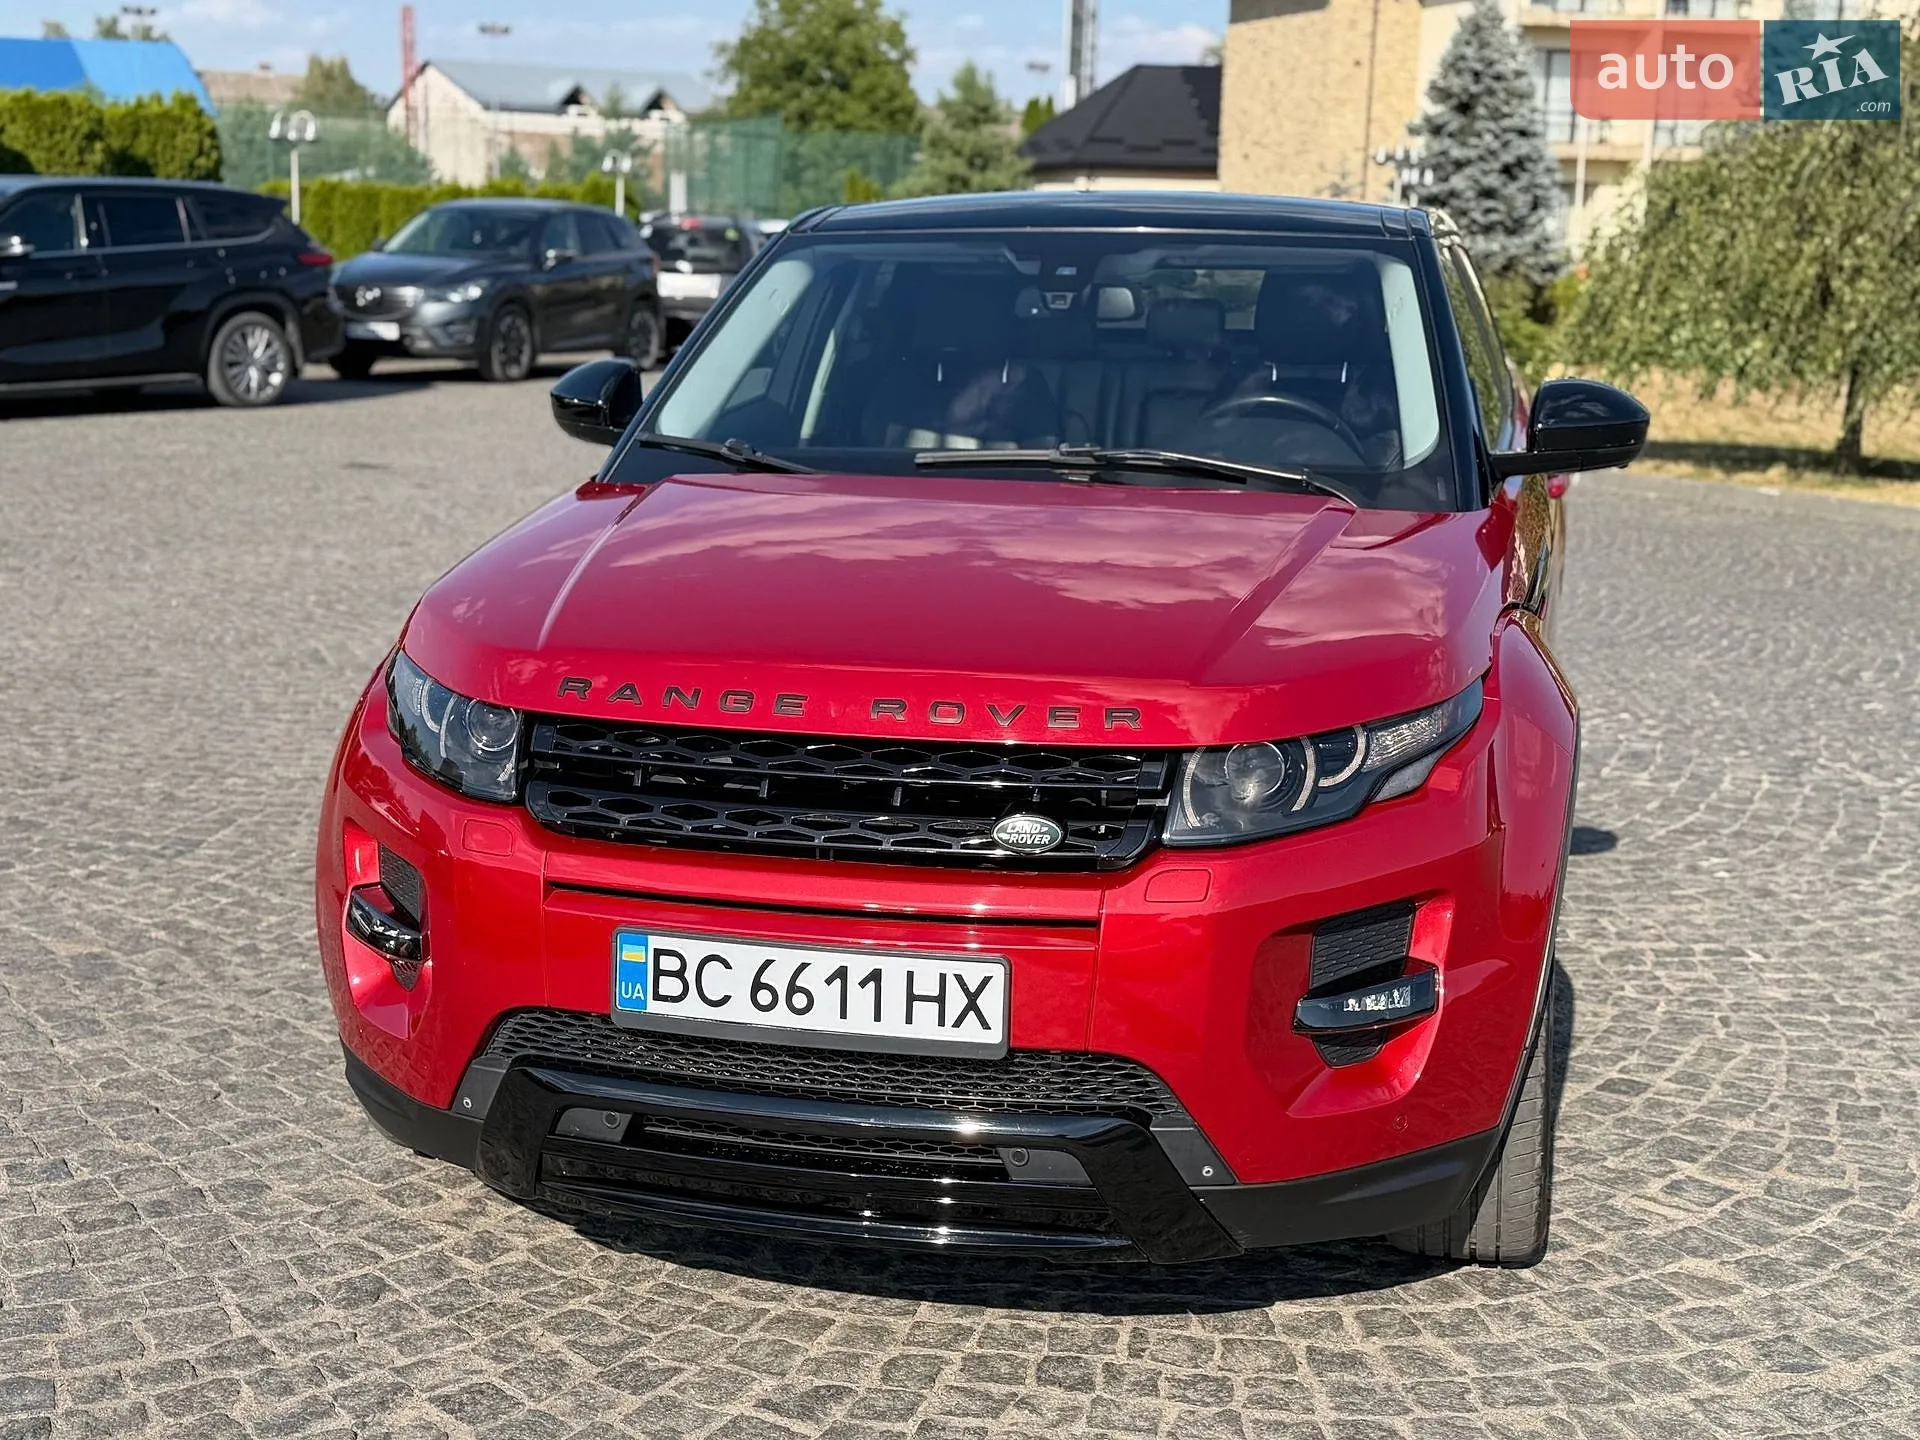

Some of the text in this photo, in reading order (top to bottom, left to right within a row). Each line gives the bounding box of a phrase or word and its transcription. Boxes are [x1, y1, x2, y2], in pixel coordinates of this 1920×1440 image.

[557, 675, 1142, 730] RANGE ROVER
[1007, 821, 1041, 833] LAND
[1009, 833, 1051, 844] ROVER
[621, 948, 994, 1031] UA BC 6611 HX
